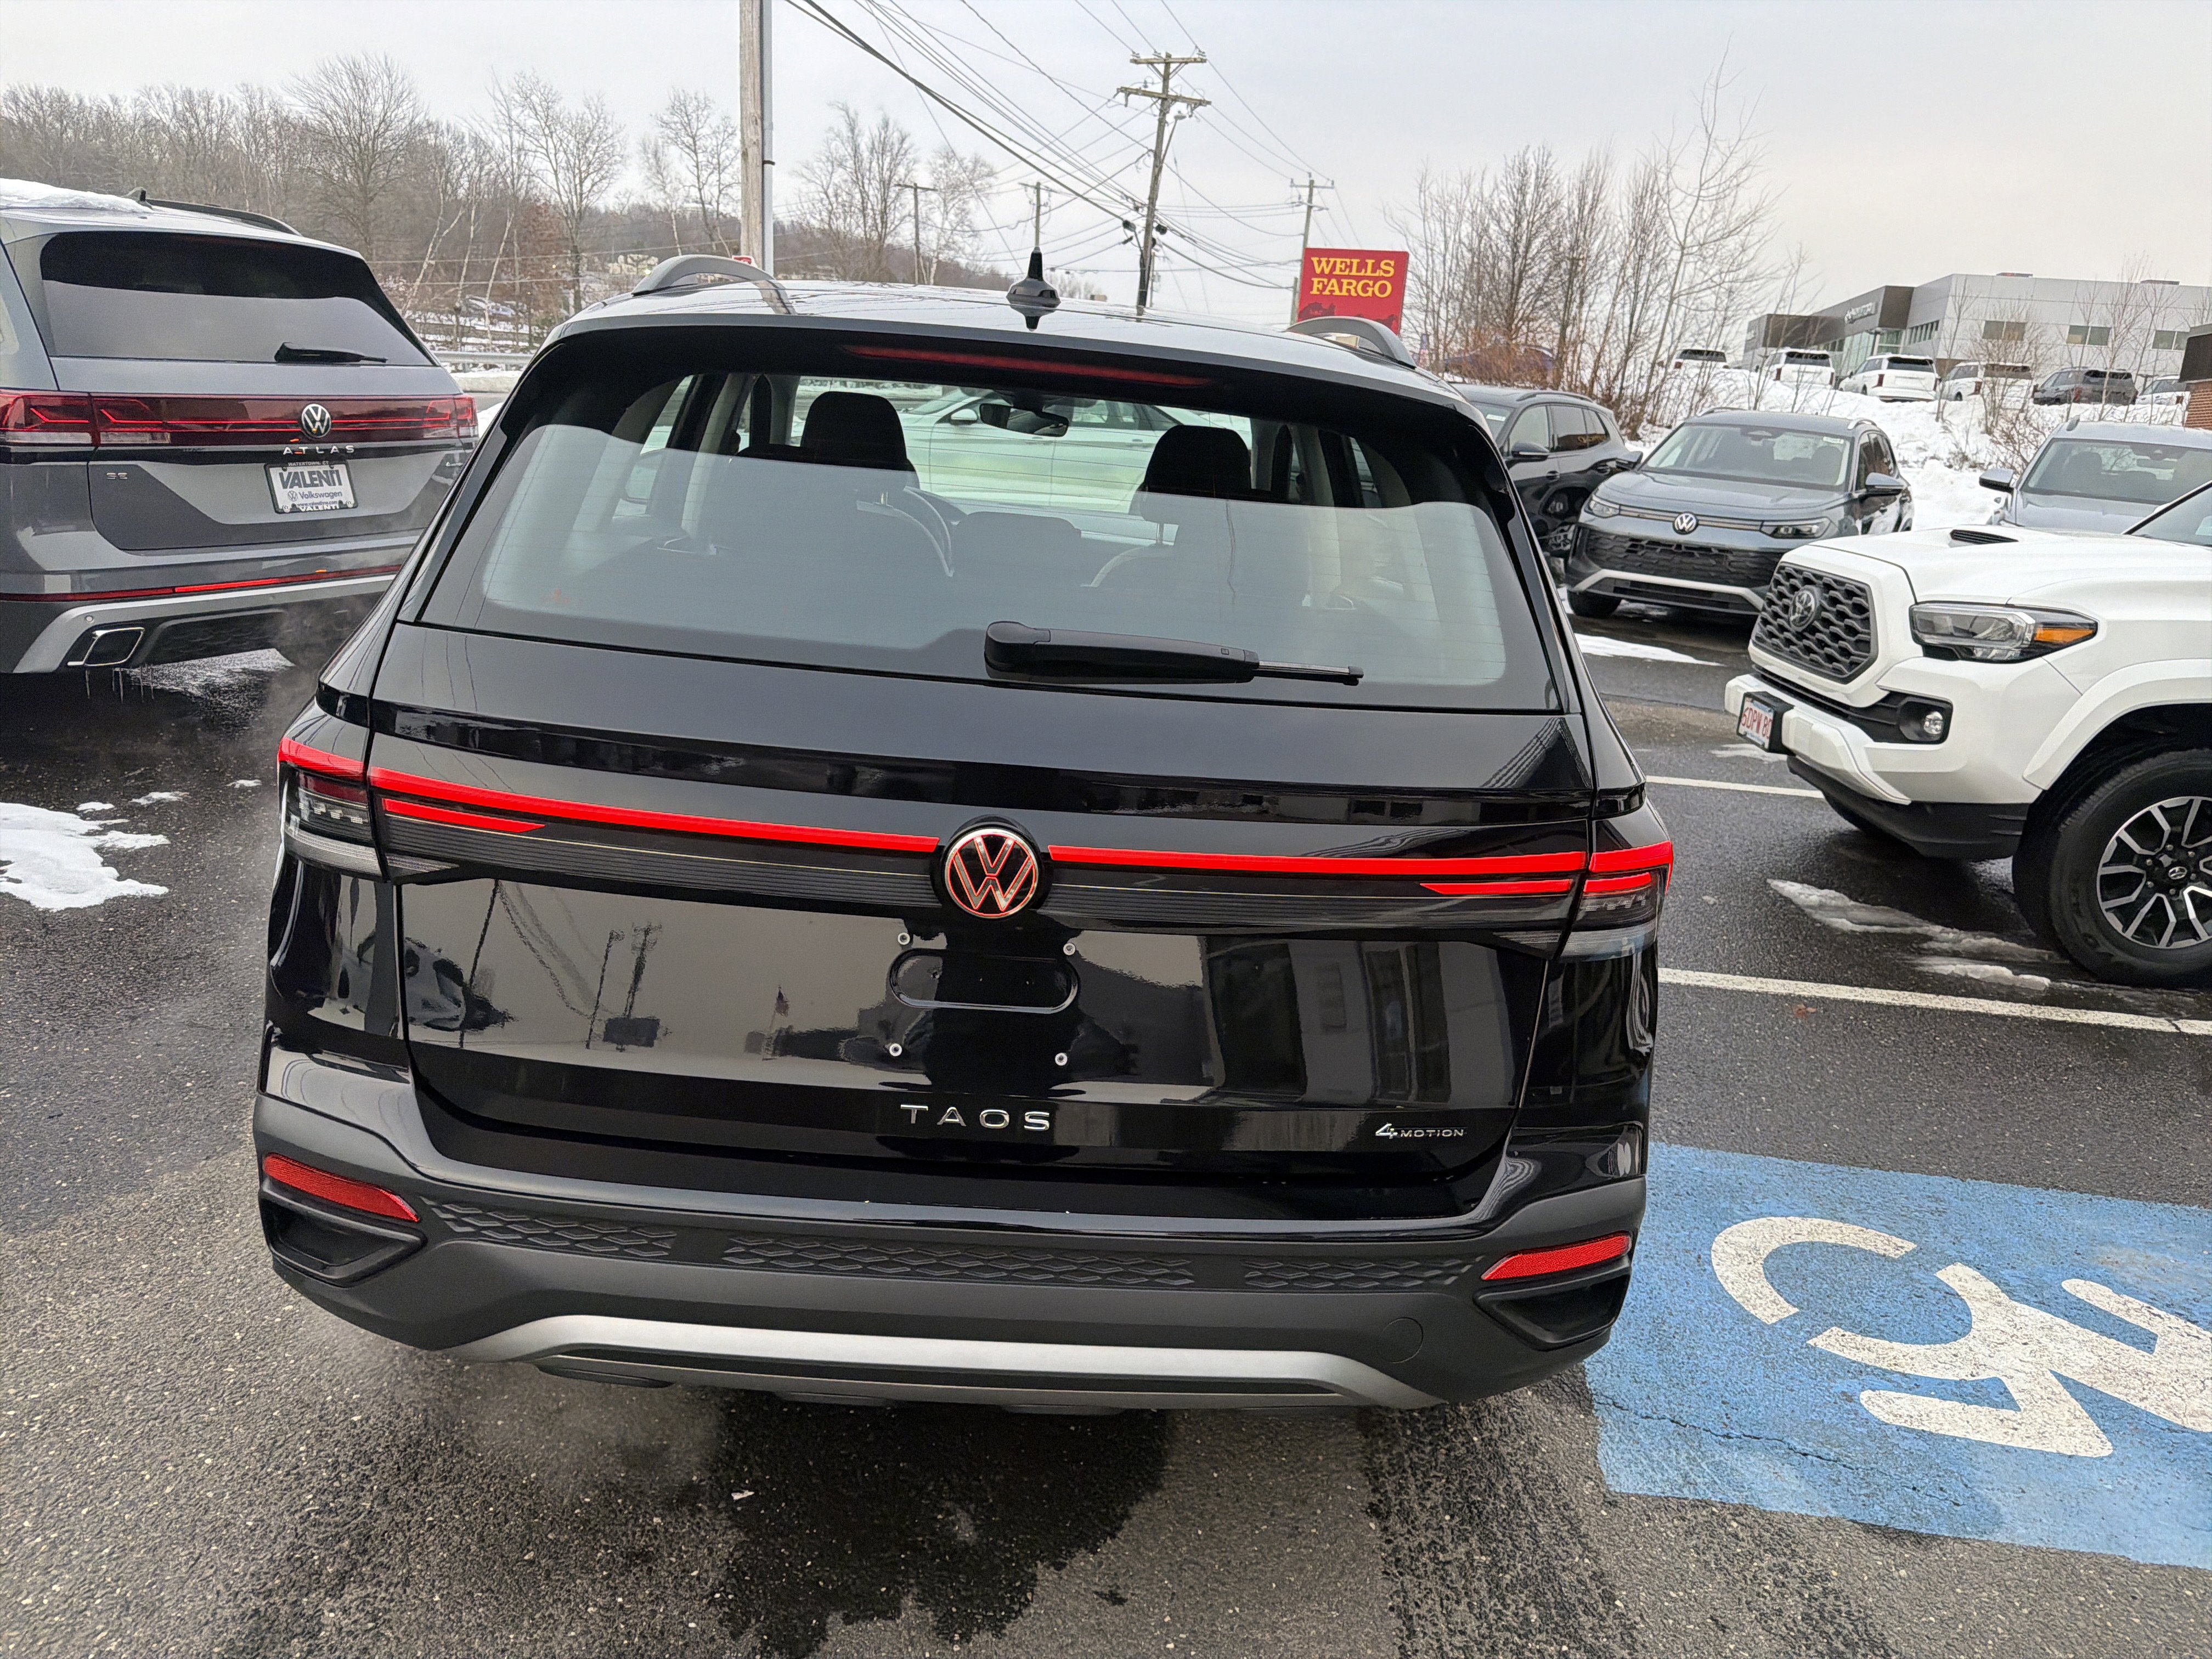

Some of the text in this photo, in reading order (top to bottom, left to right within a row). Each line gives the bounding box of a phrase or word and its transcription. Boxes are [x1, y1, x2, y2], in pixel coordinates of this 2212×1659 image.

[1311, 257, 1395, 278] WELLS
[1310, 278, 1392, 298] FARGO
[283, 445, 354, 455] ATLAS
[279, 469, 343, 490] VALENTI
[298, 491, 343, 500] Volkswagen
[900, 1104, 1050, 1131] TAOS
[1375, 1123, 1464, 1139] 4MOTION
